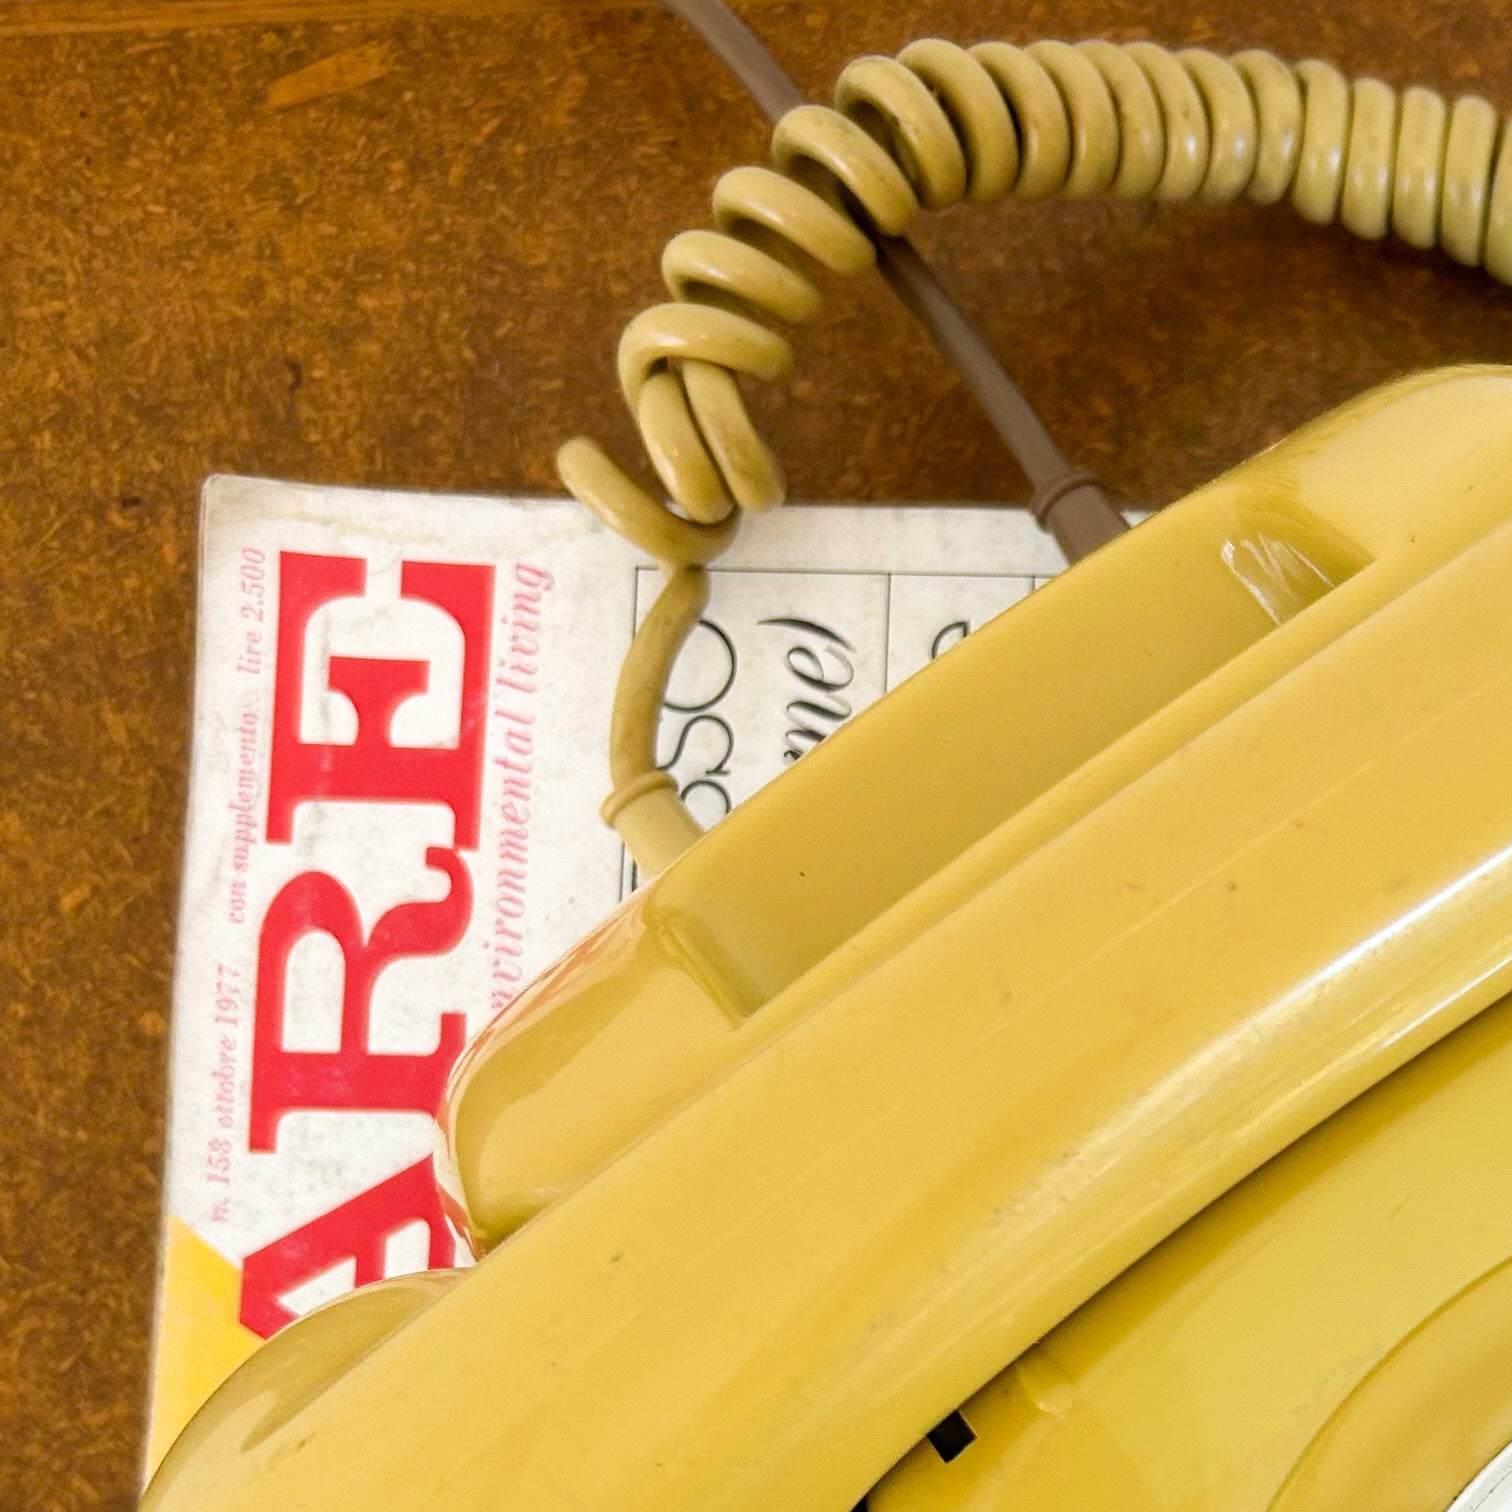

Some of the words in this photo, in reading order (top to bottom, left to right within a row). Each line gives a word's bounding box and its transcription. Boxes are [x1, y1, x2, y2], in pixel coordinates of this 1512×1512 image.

[239, 546, 267, 624] 2.500
[493, 560, 555, 695] living
[234, 631, 264, 676] lire
[228, 710, 262, 873] supplemento
[226, 880, 247, 924] con
[483, 708, 537, 1011] nvironmental
[213, 962, 241, 1027] 1977
[210, 1034, 238, 1130] ottobre
